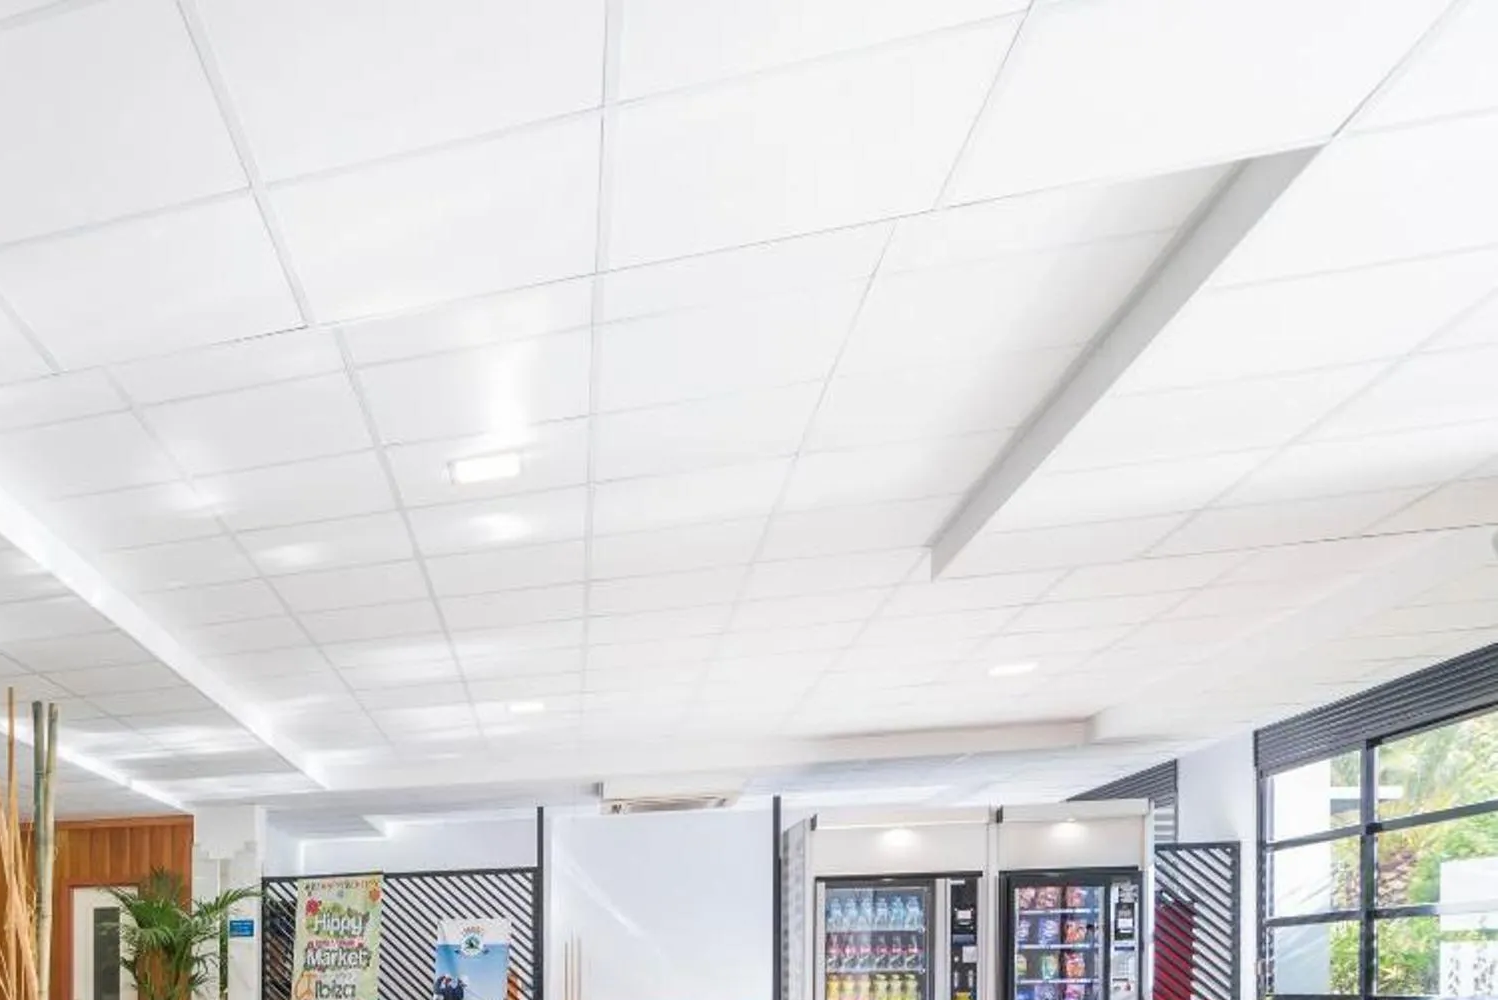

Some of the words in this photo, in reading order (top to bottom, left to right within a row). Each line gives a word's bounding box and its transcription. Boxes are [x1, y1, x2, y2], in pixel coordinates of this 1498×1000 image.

[313, 911, 363, 935] Hippy
[306, 947, 368, 967] Market
[315, 979, 356, 998] Ibiza
